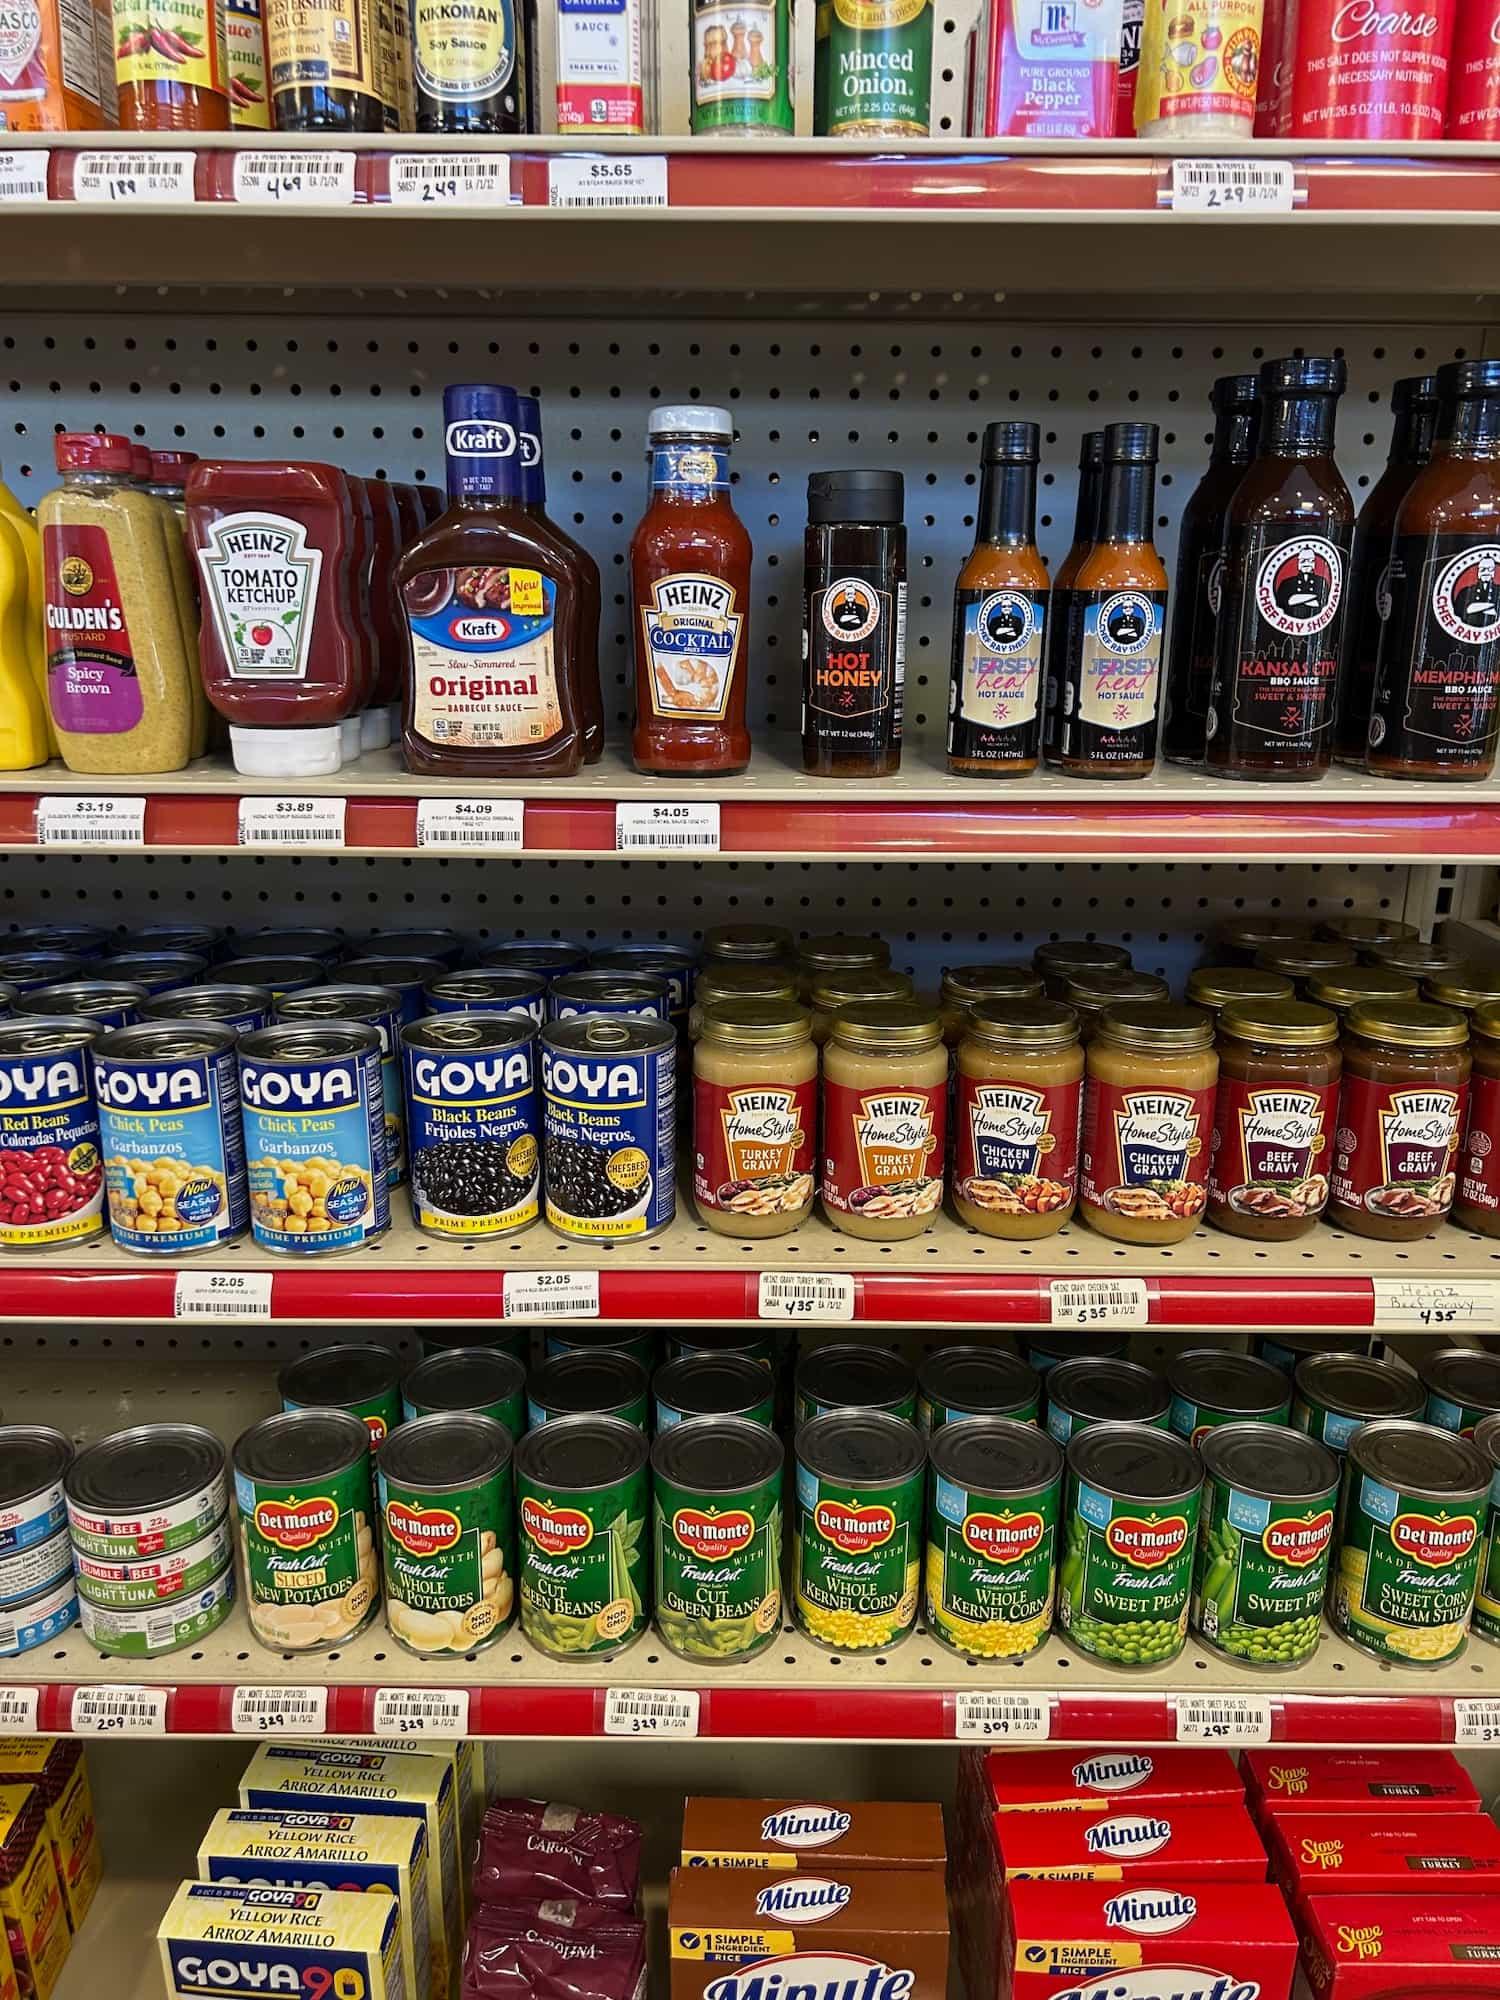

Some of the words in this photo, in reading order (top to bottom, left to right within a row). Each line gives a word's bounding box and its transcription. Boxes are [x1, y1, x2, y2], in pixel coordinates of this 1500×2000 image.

[419, 5, 498, 24] KIKKOMAN
[1188, 1, 1208, 12] ALL
[1212, 1, 1256, 15] PURPOSE
[574, 22, 611, 32] SAUCE
[1331, 0, 1439, 43] Coarse
[429, 39, 447, 51] Soy
[451, 37, 487, 50] Sauce
[840, 49, 913, 74] Minced
[1307, 57, 1325, 72] THIS
[1327, 54, 1348, 68] SALT
[1352, 51, 1378, 65] DOES
[1380, 51, 1399, 63] NOT
[1020, 68, 1045, 78] PURE
[1047, 67, 1090, 77] GROUND
[1338, 70, 1393, 85] NECESSARY
[1395, 70, 1434, 84] NUTRIENT
[1032, 78, 1076, 92] Black
[1024, 91, 1081, 109] Pepper
[591, 165, 632, 178] $5.65
[454, 428, 504, 450] Kraft
[227, 533, 287, 554] HEINZ
[220, 569, 298, 588] TOMATO
[513, 581, 539, 593] New
[227, 588, 296, 604] KETCHUP
[666, 586, 724, 610] HEINZ
[47, 599, 122, 630] GULDEN'S
[1259, 587, 1277, 623] CHEF
[1277, 616, 1304, 634] RAY
[1307, 583, 1340, 631] SHEEHAN
[462, 622, 496, 637] Kraft
[673, 618, 715, 629] ORIGINAL
[61, 632, 106, 642] MUSTARD
[653, 631, 731, 649] COCKTAIL
[447, 659, 516, 669] Slow-Simmered
[827, 653, 870, 669] HOT
[1088, 658, 1160, 676] JERSEY
[1241, 660, 1308, 676] KANSAS
[1312, 660, 1337, 676] CITY
[68, 667, 104, 682] Spicy
[816, 670, 882, 687] HONEY
[1270, 677, 1290, 686] BBQ
[1293, 677, 1320, 686] SAUCE
[66, 681, 111, 695] Brown
[429, 675, 538, 701] Original
[1098, 692, 1116, 700] HOT
[1119, 691, 1145, 700] SAUCE
[448, 704, 491, 713] BARBECUE
[495, 704, 522, 713] SAUCE
[76, 802, 113, 812] $3.19
[276, 802, 314, 812] $3.89
[455, 804, 492, 815] $4.09
[653, 808, 689, 818] $4.05
[416, 1053, 528, 1096] GOYA
[241, 1066, 355, 1105] GOYA
[737, 1095, 787, 1113] HEINZ
[984, 1094, 1033, 1113] HEINZ
[1258, 1098, 1311, 1114] HEINZ
[3, 1116, 29, 1132] Red
[32, 1113, 70, 1131] Beans
[431, 1108, 471, 1123] Black
[476, 1105, 517, 1121] Beans
[109, 1115, 144, 1133] Chick
[150, 1116, 184, 1132] Peas
[259, 1115, 296, 1134] Chick
[301, 1116, 335, 1133] Peas
[424, 1122, 476, 1139] Frijoles
[479, 1120, 524, 1138] Negros
[726, 1117, 795, 1140] HomeStyle
[973, 1112, 1041, 1137] HomeStyle
[1244, 1118, 1317, 1141] HomeStyle
[1, 1131, 54, 1147] Coloradas
[111, 1138, 183, 1155] Garbanzos
[259, 1138, 333, 1156] Garbanzos
[740, 1148, 783, 1160] TURKEY
[982, 1144, 1030, 1159] CHICKEN
[1266, 1151, 1295, 1162] BEEF
[607, 1160, 650, 1173] CHEFSBEST
[742, 1159, 780, 1171] GRAVY
[985, 1156, 1024, 1170] GRAVY
[1258, 1160, 1299, 1173] GRAVY
[434, 1217, 466, 1228] PRIME
[472, 1212, 524, 1228] PREMIUM
[211, 1277, 245, 1288] $2.05
[537, 1275, 571, 1286] $2.05
[1401, 1285, 1459, 1298] Heinz
[1391, 1297, 1424, 1309] Beef
[1434, 1297, 1474, 1316] Gravy
[260, 1511, 282, 1529] Del
[284, 1508, 333, 1529] Monte
[279, 1530, 312, 1542] Quality
[679, 1520, 701, 1537] Del
[702, 1521, 749, 1539] Monte
[697, 1540, 728, 1553] Quality
[132, 1567, 157, 1579] BEE
[276, 1570, 324, 1587] SLICED
[255, 1581, 281, 1603] NEW
[284, 1576, 353, 1603] POTATOES
[401, 1572, 446, 1594] WHOLE
[825, 1576, 877, 1596] WHOLE
[87, 1584, 119, 1600] LIGHT
[120, 1587, 156, 1601] TUNA
[696, 1587, 729, 1604] CUT
[805, 1581, 859, 1610] KERNEL
[861, 1592, 898, 1611] CORN
[1094, 1587, 1149, 1612] SWEET
[1154, 1588, 1185, 1610] PEAS
[1381, 1583, 1431, 1608] SWEET
[1433, 1590, 1467, 1608] CORN
[668, 1591, 711, 1618] GREEN
[714, 1596, 761, 1618] BEANS
[1379, 1600, 1430, 1623] CREAM
[1433, 1606, 1465, 1624] STYLE
[470, 1609, 491, 1624] NON
[471, 1617, 493, 1631] GMO
[1072, 1755, 1153, 1787] Minute
[1268, 1765, 1309, 1787] Stove
[1286, 1778, 1308, 1796] Top
[761, 1806, 852, 1840] Minute
[267, 1830, 321, 1844] YELLOW
[326, 1833, 356, 1845] RICE
[242, 1843, 292, 1858] ARROZ
[295, 1846, 369, 1861] AMARILLO
[1420, 1860, 1462, 1870] TURKEY
[756, 1880, 852, 1913] Minute
[715, 1934, 765, 1946] SIMPLE
[715, 1944, 771, 1953] INGREDIENT
[715, 1954, 742, 1962] RICE
